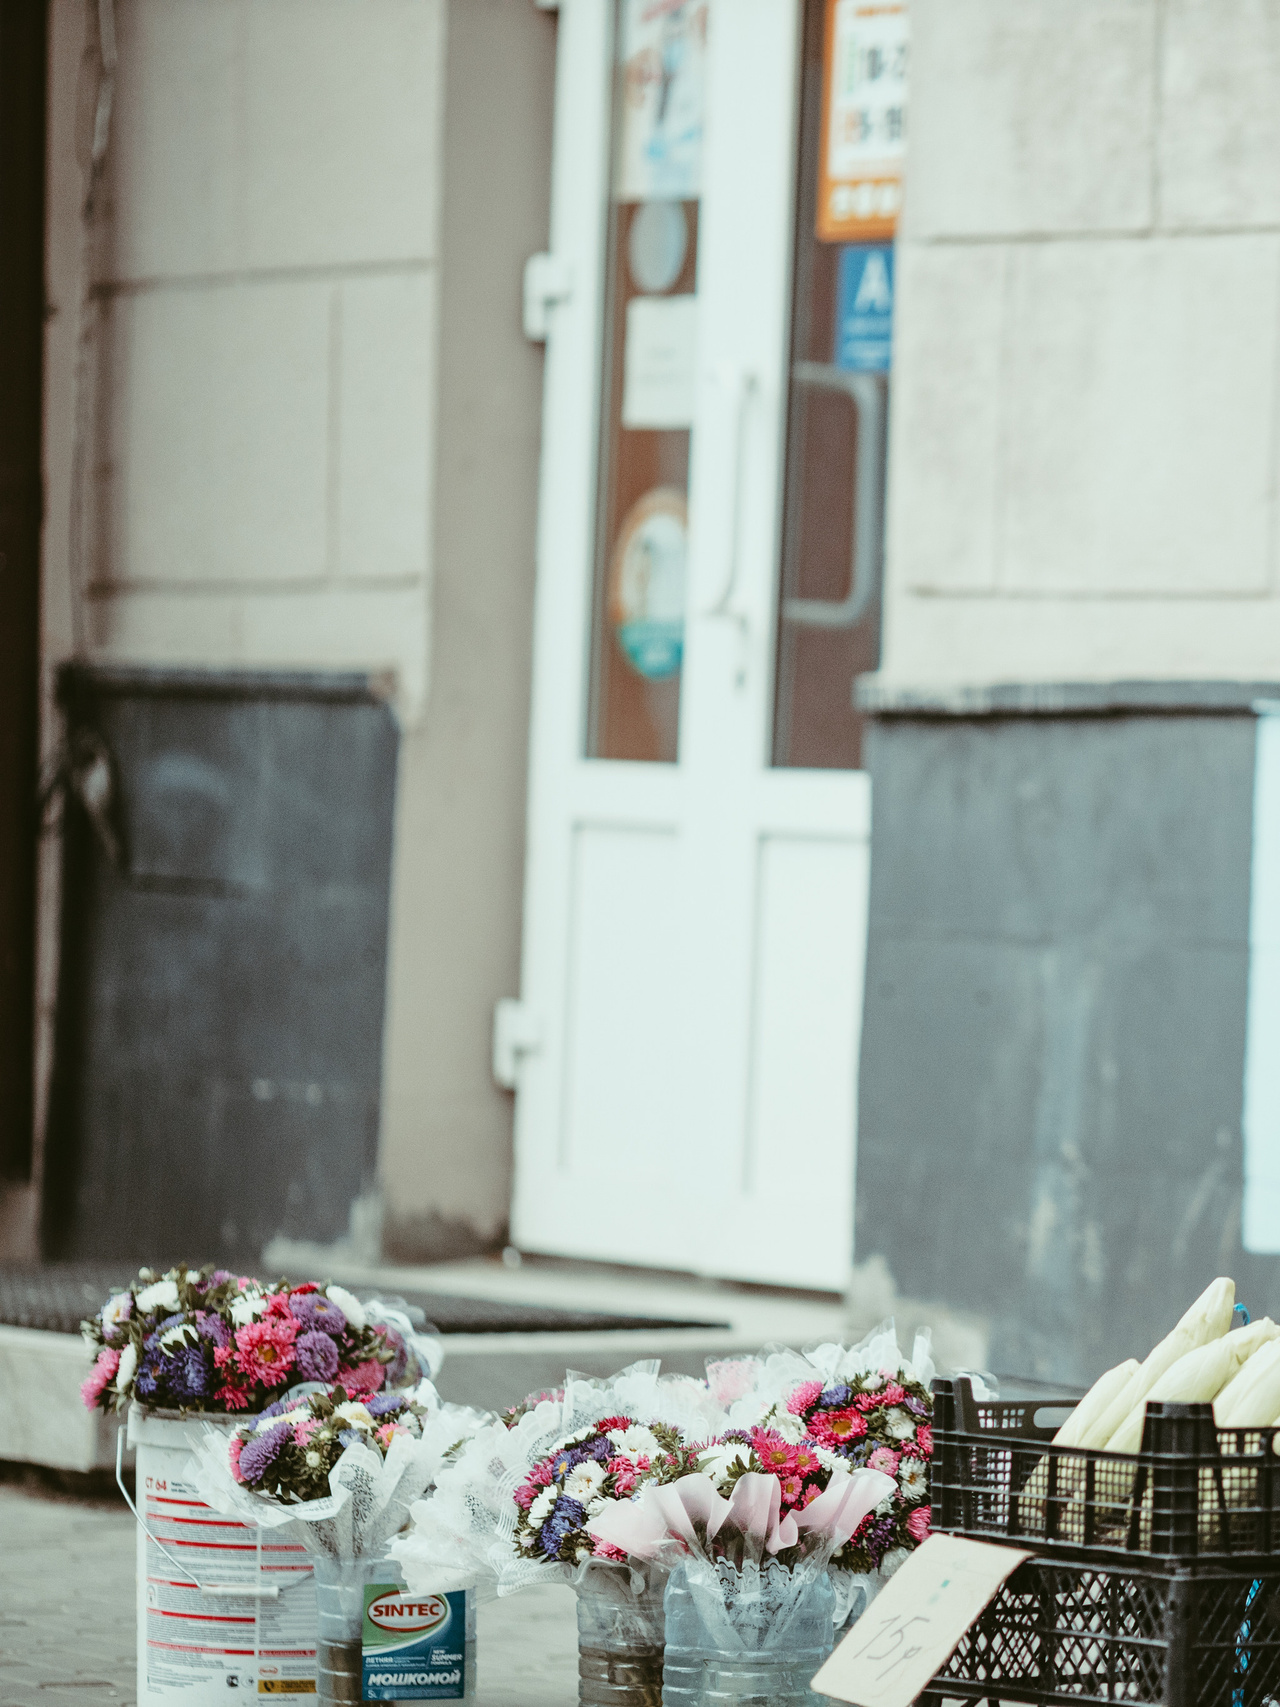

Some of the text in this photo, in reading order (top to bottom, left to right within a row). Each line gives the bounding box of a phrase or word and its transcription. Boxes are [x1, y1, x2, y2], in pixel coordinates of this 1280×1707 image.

[373, 1603, 440, 1617] SINTEC
[431, 1653, 463, 1661] SUMMER
[367, 1668, 461, 1686] МОШКОМОЙ
